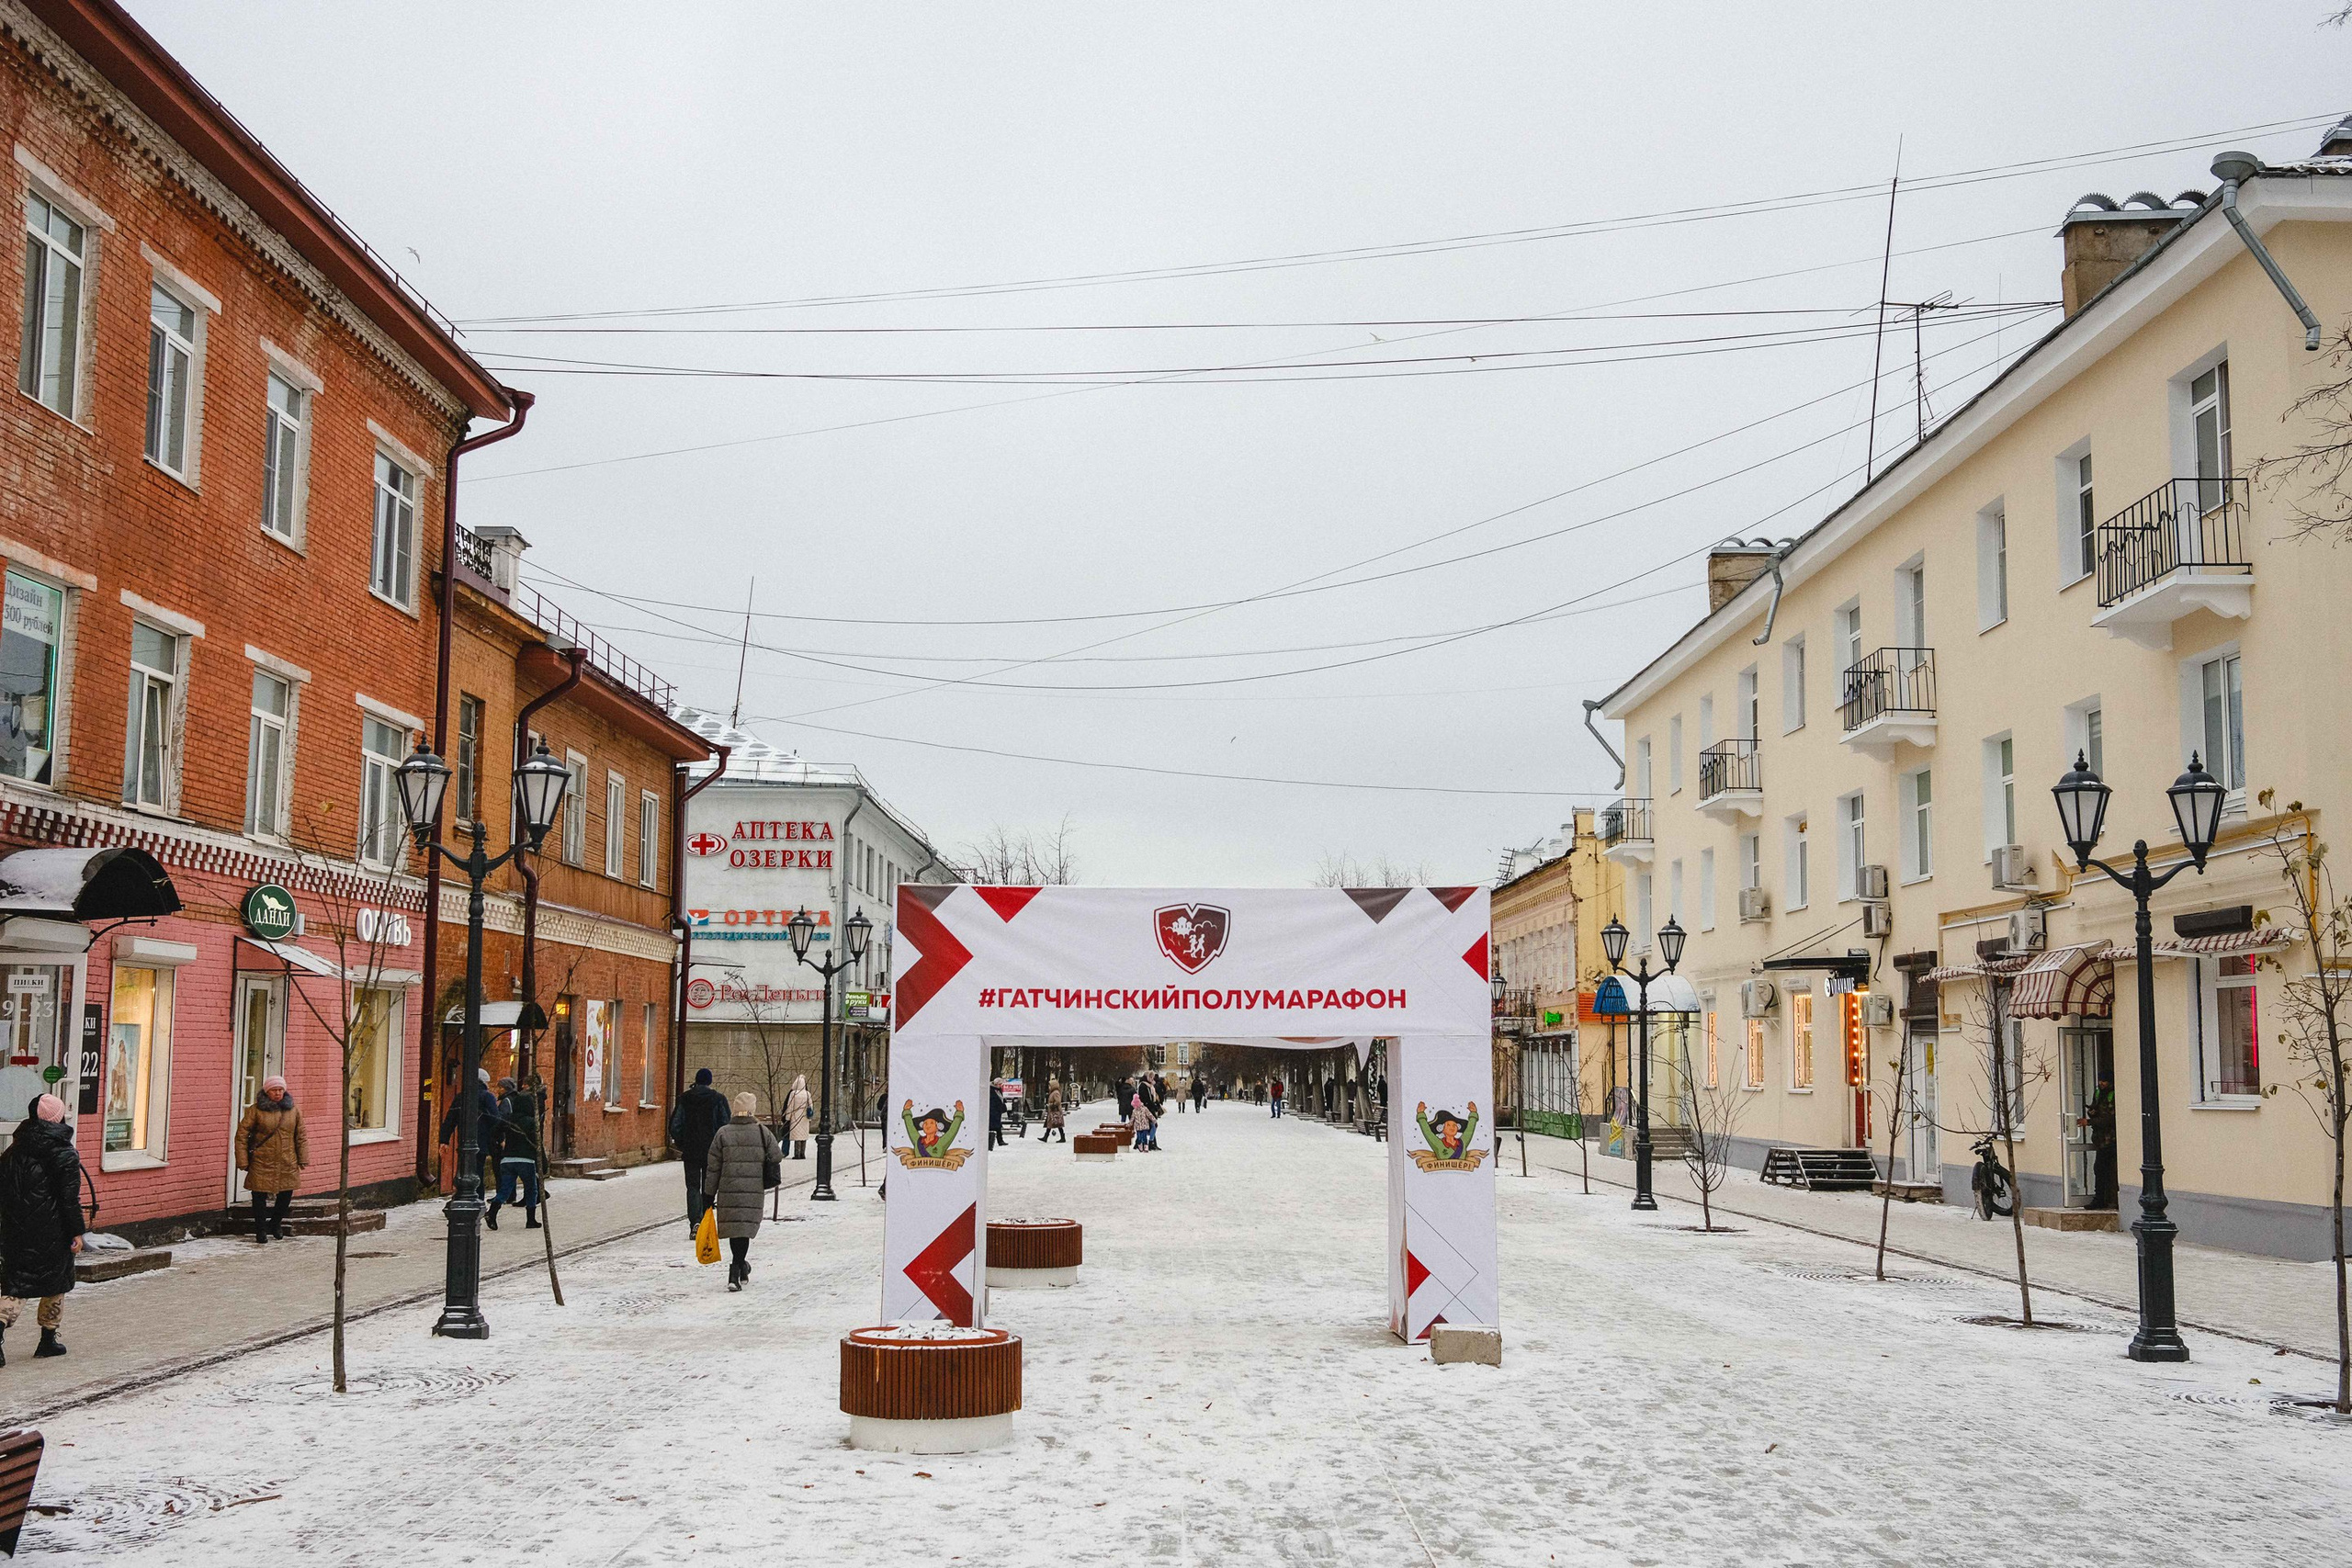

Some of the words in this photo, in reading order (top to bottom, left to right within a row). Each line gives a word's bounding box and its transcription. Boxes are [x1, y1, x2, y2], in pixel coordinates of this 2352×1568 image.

[5, 579, 43, 607] Дизайн
[23, 615, 53, 636] рублей
[731, 820, 834, 840] АПТЕКА
[729, 849, 833, 869] ОЗЕРКИ
[254, 908, 291, 927] ДАНДИ
[691, 931, 788, 942] РТОПЕДИЧЕСКИЙ
[720, 984, 826, 1003] РосДеньги
[978, 984, 1407, 1010] #ГАТЧИНСКИЙПОЛУМАРАФОН
